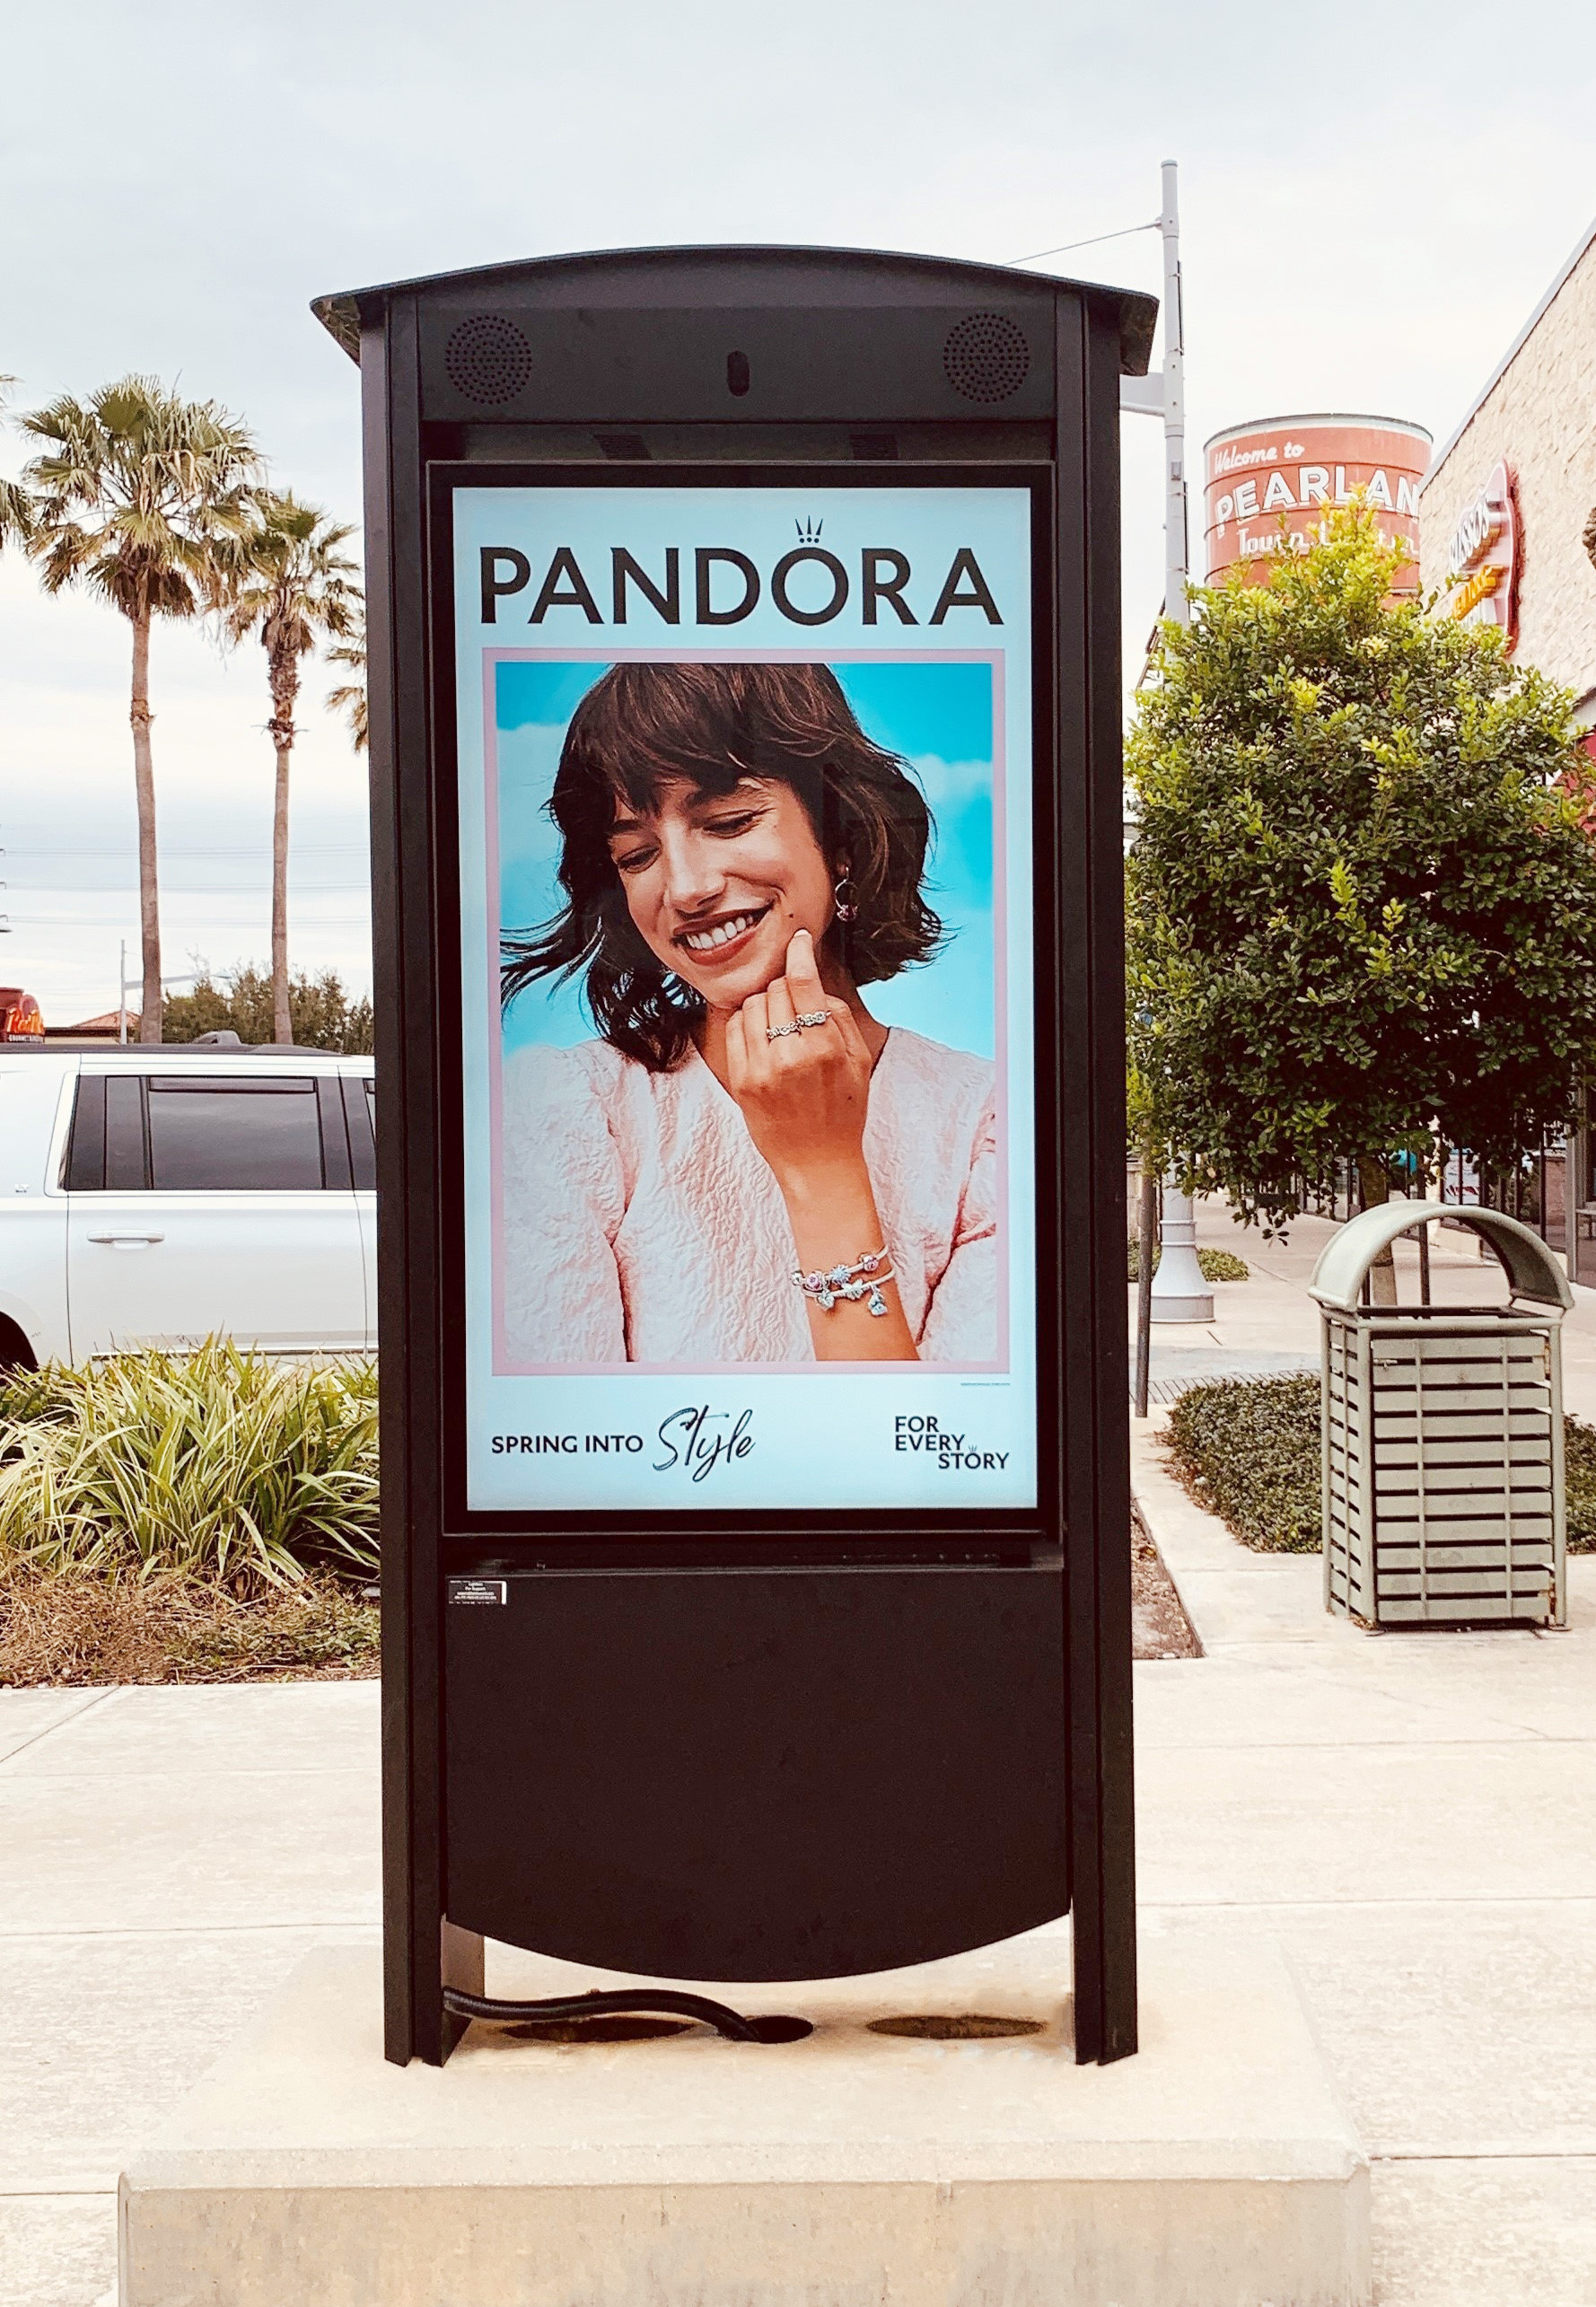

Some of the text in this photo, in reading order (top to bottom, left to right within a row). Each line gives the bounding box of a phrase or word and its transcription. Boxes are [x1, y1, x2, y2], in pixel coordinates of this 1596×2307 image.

[1215, 442, 1305, 476] Welcome to
[1216, 464, 1419, 539] PEARLAN
[479, 546, 1005, 627] PANDORA
[894, 1416, 939, 1433] FOR
[491, 1404, 756, 1482] SPRING INTO Style
[894, 1434, 966, 1451] EVERY
[938, 1452, 1010, 1469] STORY
